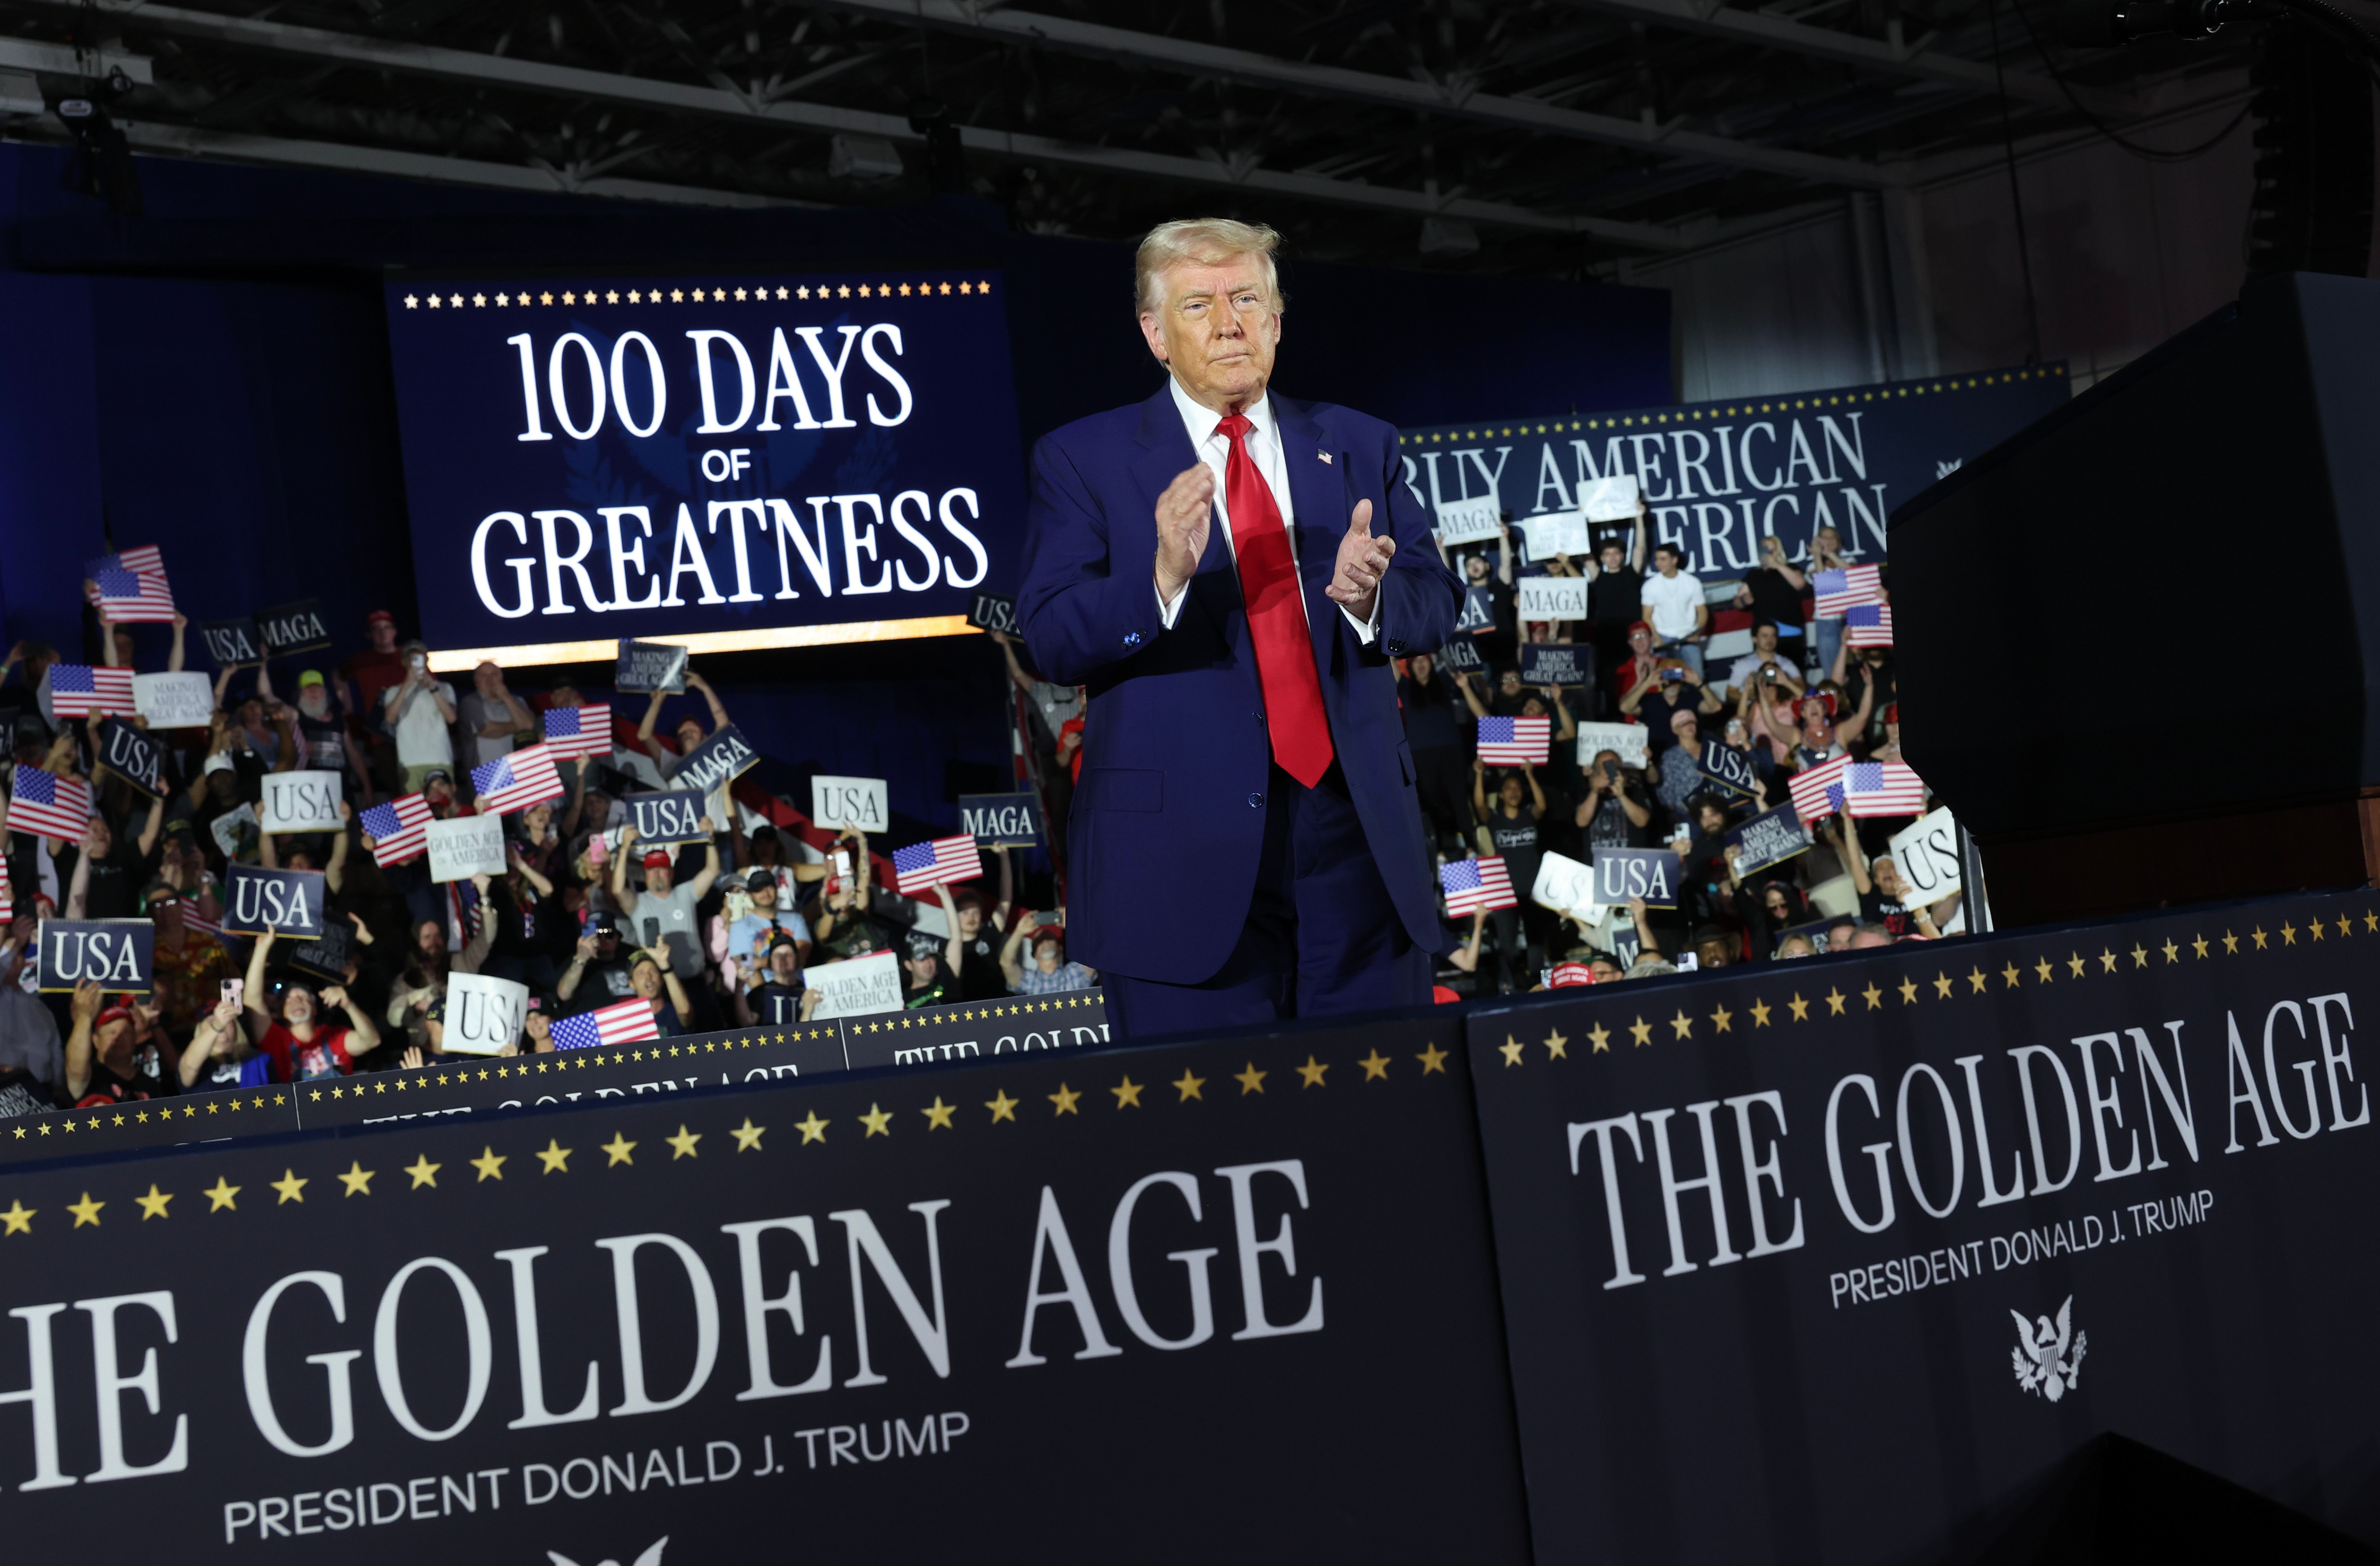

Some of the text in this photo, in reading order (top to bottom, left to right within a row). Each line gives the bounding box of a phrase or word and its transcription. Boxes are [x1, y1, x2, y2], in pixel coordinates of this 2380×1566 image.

[507, 322, 914, 442] 100 DAYS
[701, 448, 751, 483] OF
[1442, 508, 1499, 537] MAGA
[470, 487, 989, 619] GREATNESS
[1522, 585, 1584, 613] MAGA
[204, 628, 256, 662] USA
[259, 611, 326, 648] MAGA
[109, 726, 158, 791] USA
[681, 735, 753, 789] MAGA
[1707, 741, 1757, 789] USA
[272, 783, 338, 822] USA
[633, 797, 700, 839] USA
[821, 786, 880, 824] USA
[962, 806, 1035, 837] MAGA
[1601, 857, 1670, 899] USA
[1901, 828, 1960, 890] US
[236, 876, 313, 928] USA
[53, 932, 142, 981] USA
[872, 970, 898, 989] AGE
[459, 990, 523, 1045] USA
[833, 988, 895, 1013] AMERICA
[1566, 992, 2371, 1290] THE GOLDEN AGE
[1830, 1189, 2215, 1310] PRESIDENT DONALD J. TRUMP
[242, 1199, 952, 1458] GOLDEN
[1005, 1159, 1325, 1369] AGE
[223, 1410, 971, 1545] PRESIDENT DONALD J. TRUMP
